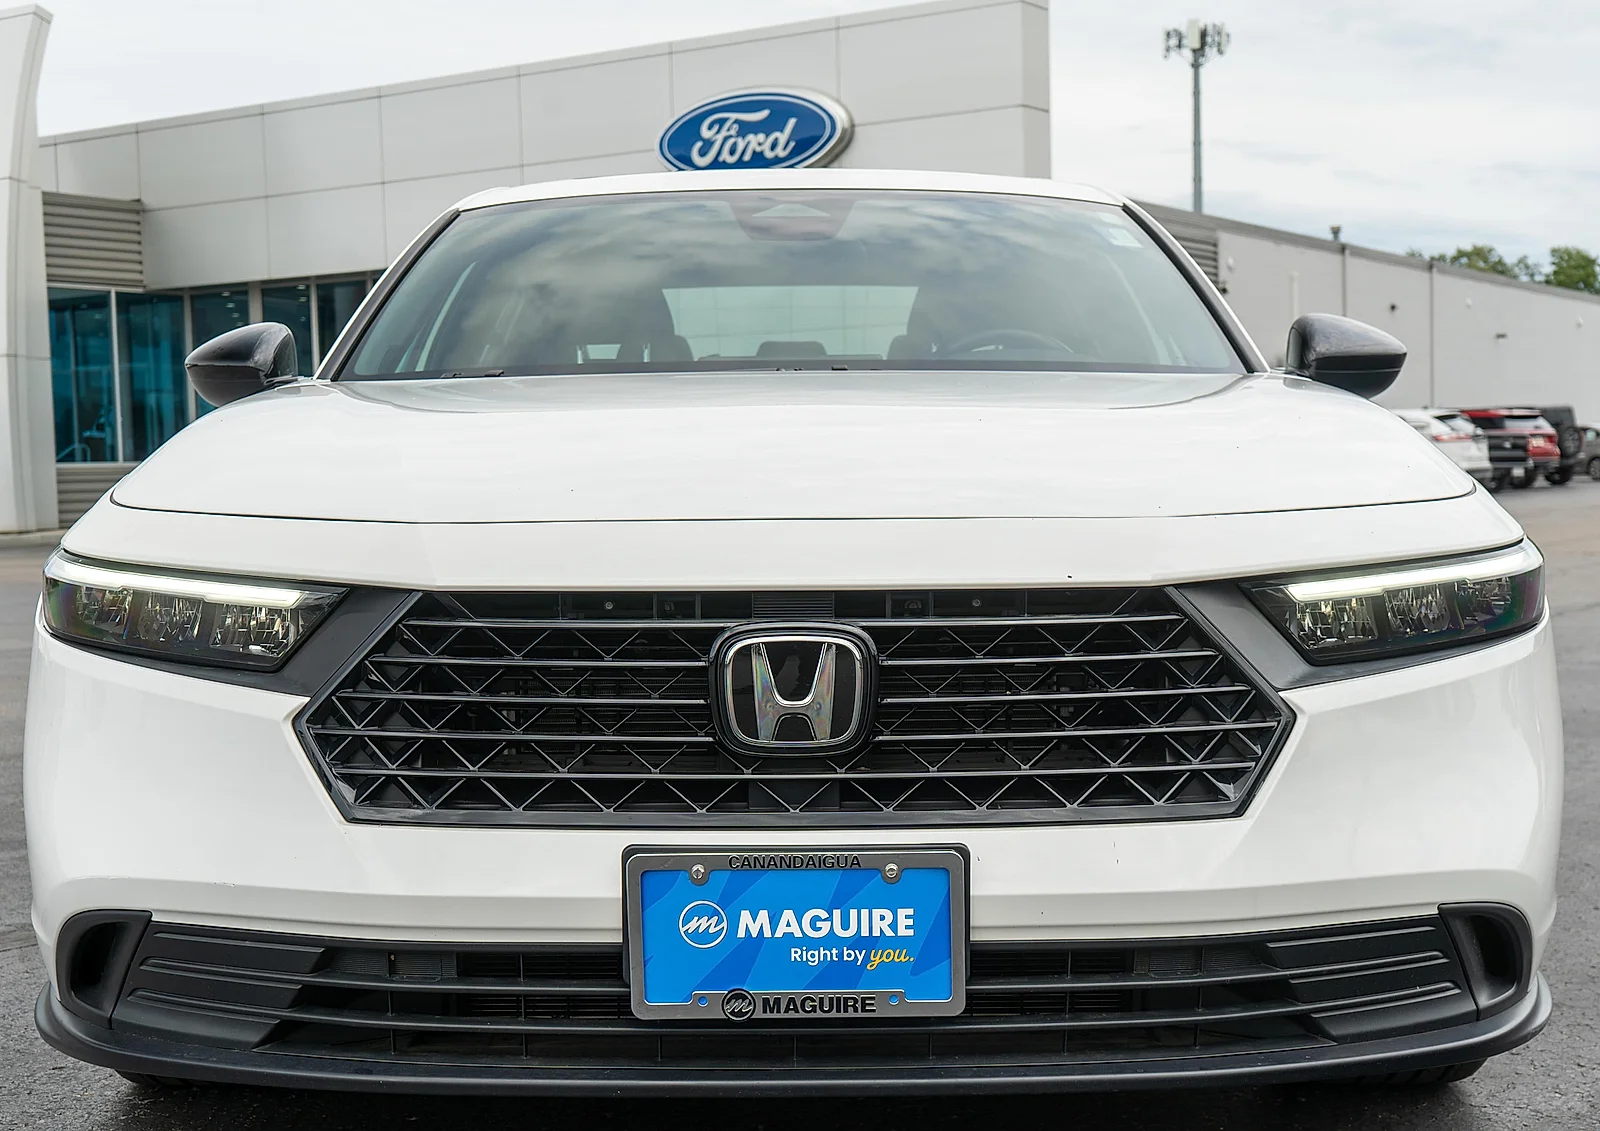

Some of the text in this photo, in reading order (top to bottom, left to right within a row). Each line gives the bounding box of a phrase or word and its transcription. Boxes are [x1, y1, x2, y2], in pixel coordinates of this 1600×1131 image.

[690, 108, 798, 168] Ford
[728, 854, 862, 870] CANANDAIGUA
[736, 907, 916, 939] MAGUIRE
[790, 946, 915, 971] Right by you.
[761, 994, 877, 1015] MAGUIRE
